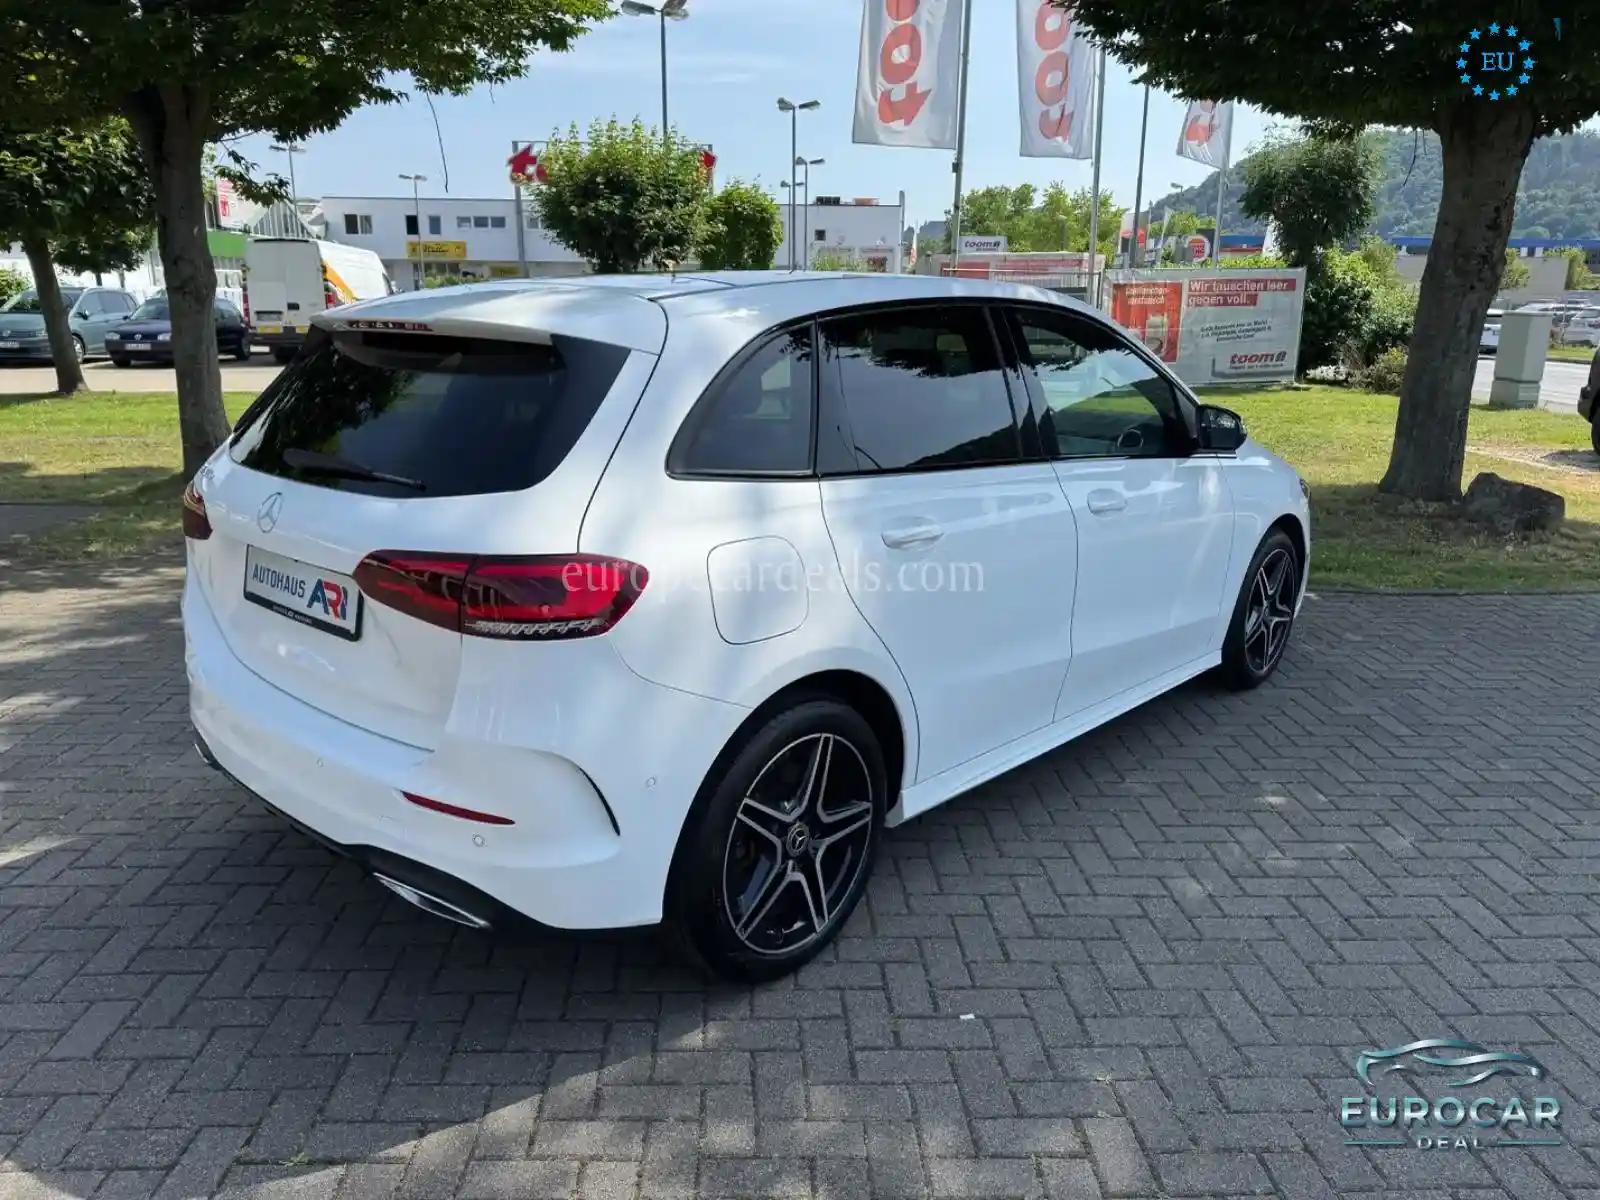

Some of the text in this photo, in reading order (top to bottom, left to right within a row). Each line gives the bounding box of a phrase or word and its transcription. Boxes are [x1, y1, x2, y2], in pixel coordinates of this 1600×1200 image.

[965, 240, 993, 249] toom
[1190, 280, 1289, 291] Wir tauschen leer
[1187, 294, 1224, 307] gegen
[1230, 352, 1276, 365] toom
[252, 563, 306, 598] AUTOHAUS
